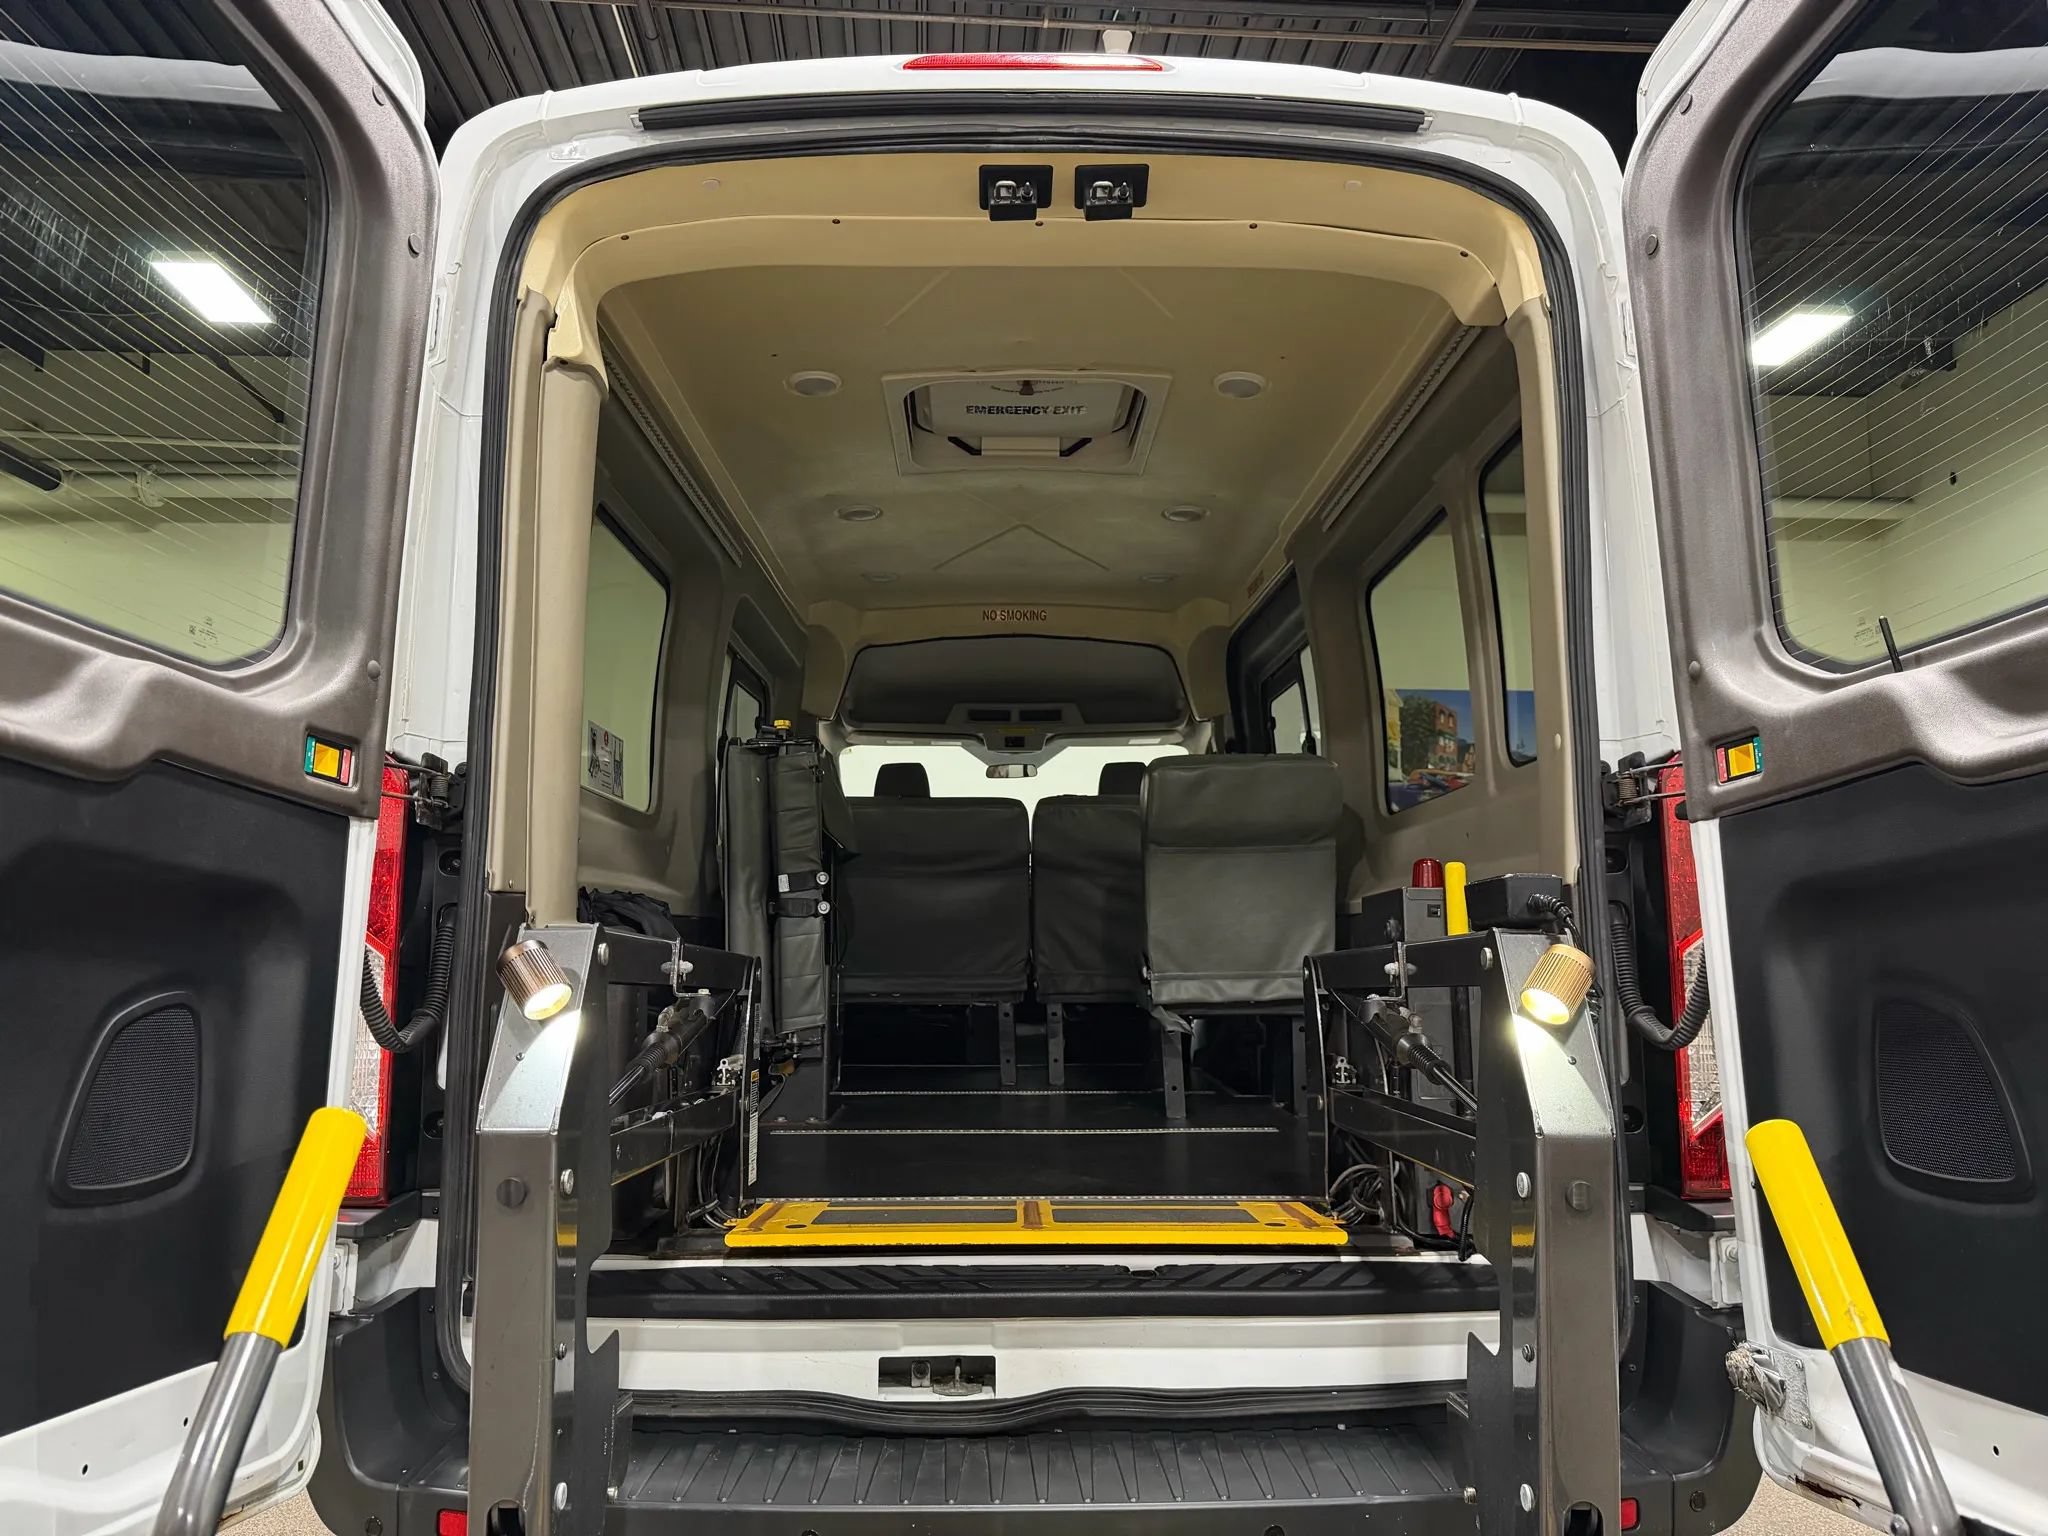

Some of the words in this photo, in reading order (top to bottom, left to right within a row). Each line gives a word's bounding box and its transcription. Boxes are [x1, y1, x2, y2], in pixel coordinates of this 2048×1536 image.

[966, 405, 1049, 415] EMERGENCY
[1052, 405, 1085, 415] EXIT
[982, 610, 997, 621] NO
[1000, 610, 1047, 621] SMOKING
